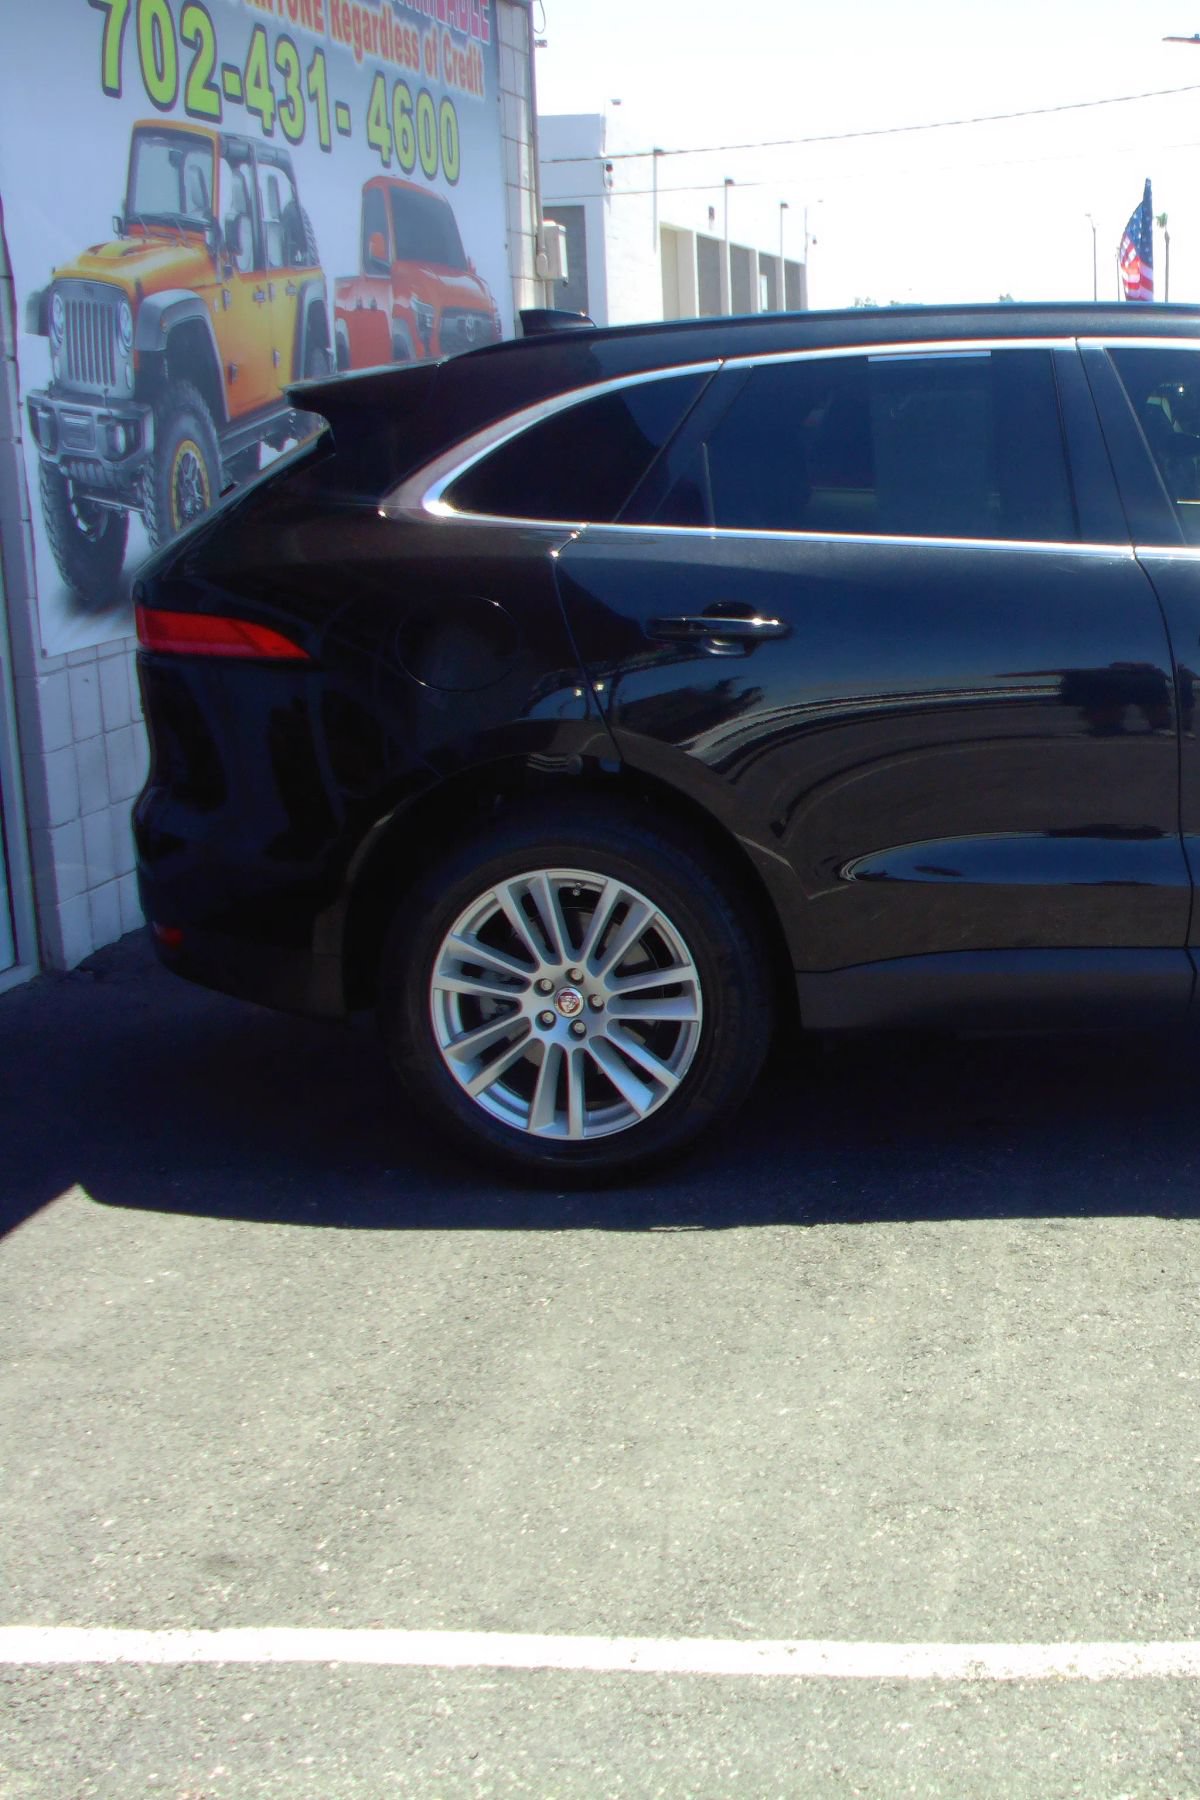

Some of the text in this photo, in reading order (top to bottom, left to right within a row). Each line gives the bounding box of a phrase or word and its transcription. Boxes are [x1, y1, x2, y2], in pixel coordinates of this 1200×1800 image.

[329, 0, 420, 71] Regardless
[424, 27, 438, 79] of
[442, 31, 485, 97] Credit
[367, 70, 461, 186] 4600
